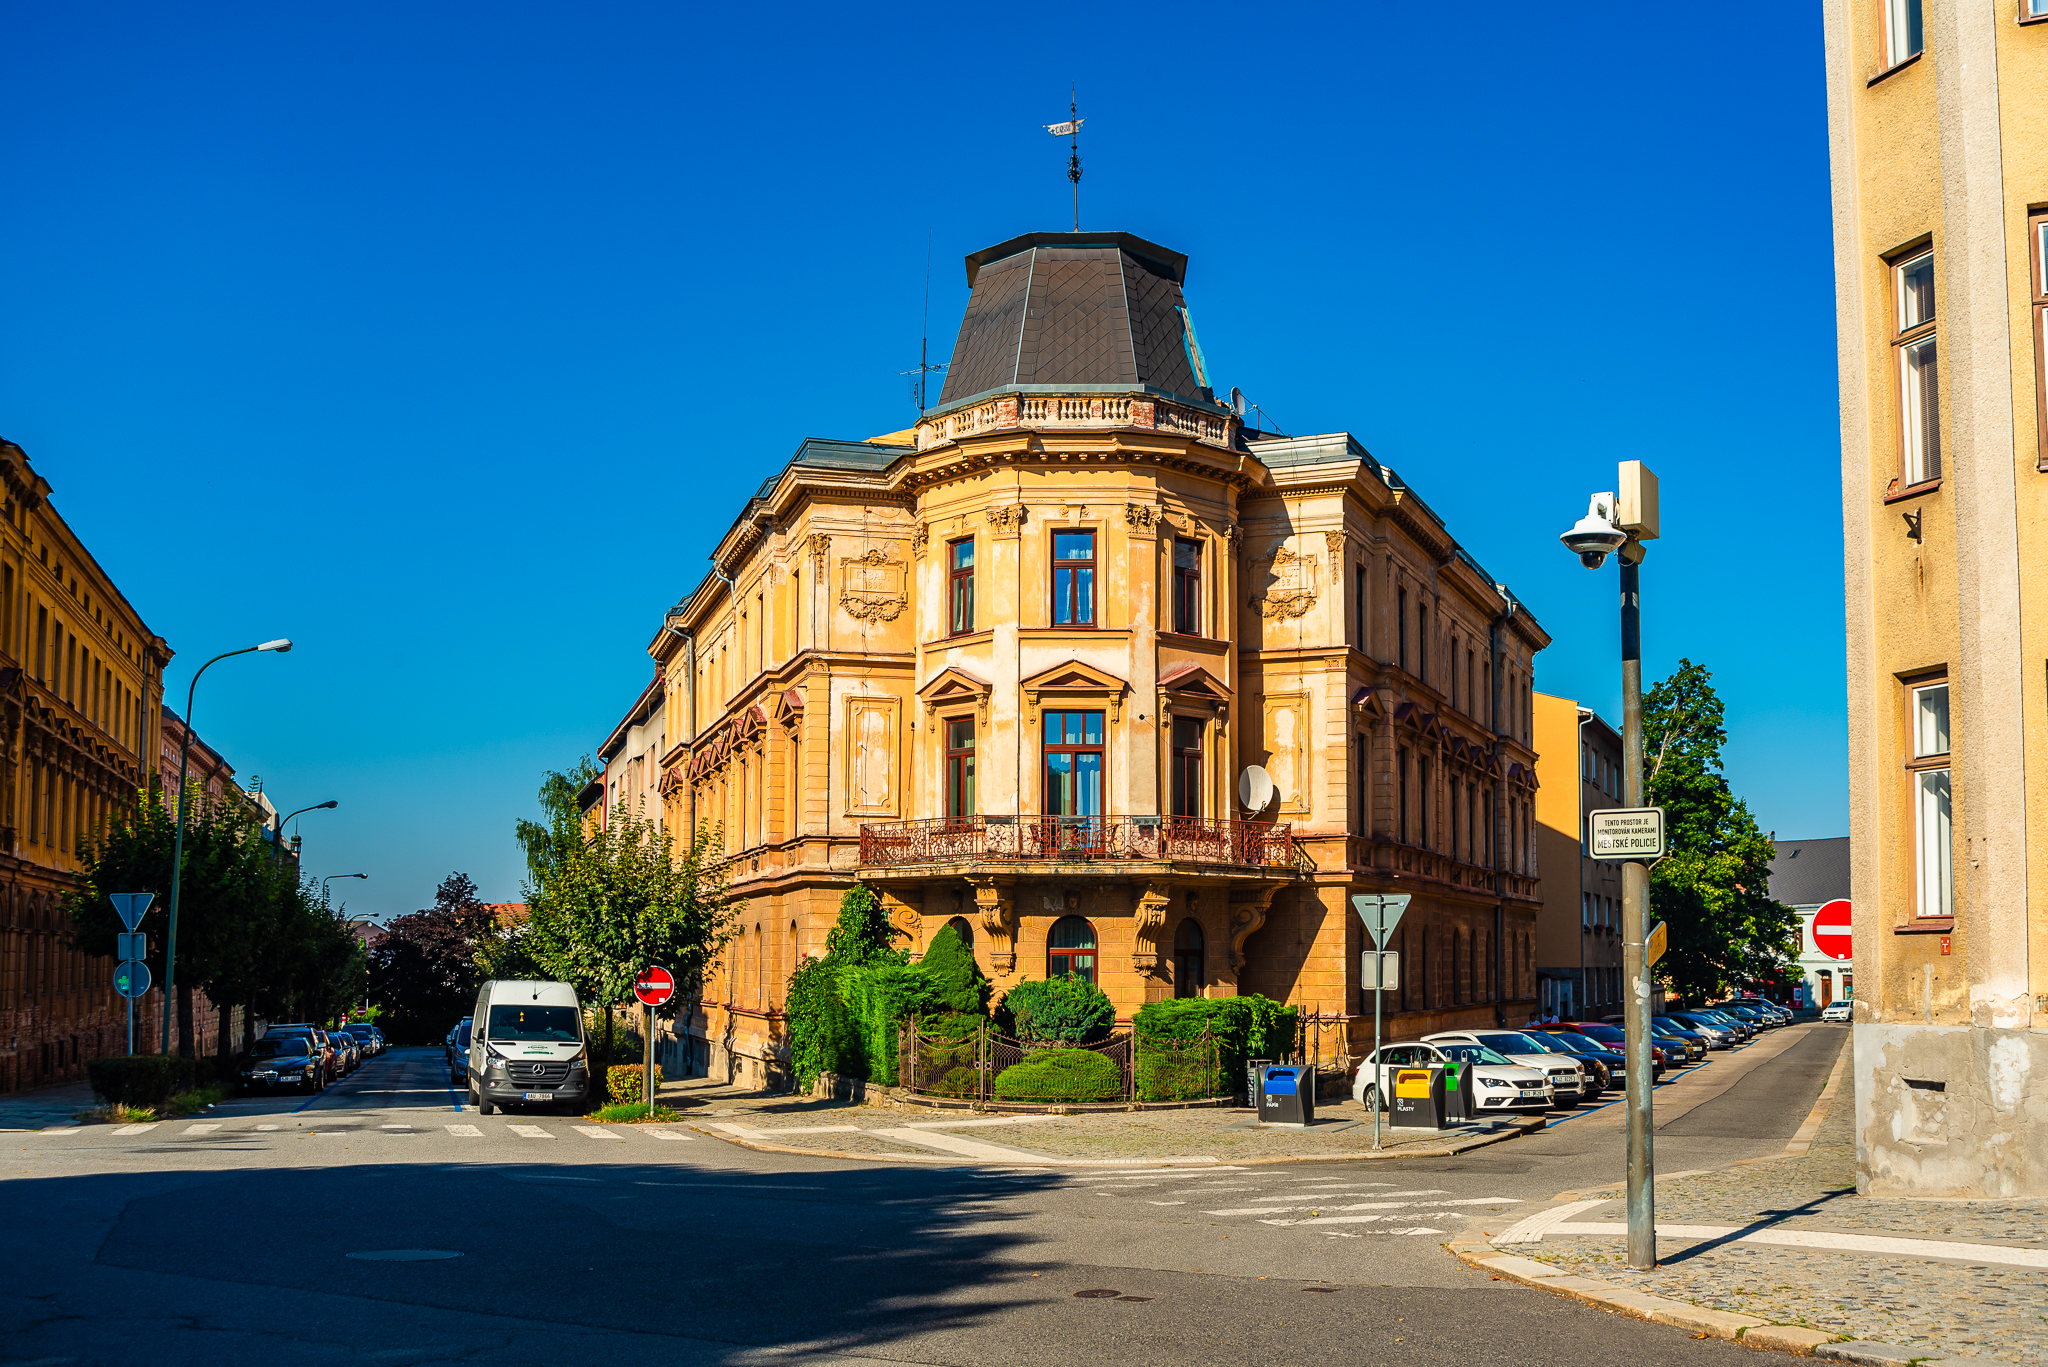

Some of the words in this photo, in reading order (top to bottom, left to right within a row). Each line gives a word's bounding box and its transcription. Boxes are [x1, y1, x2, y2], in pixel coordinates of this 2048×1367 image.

[1597, 827, 1630, 835] MONITOROVÁN
[1597, 837, 1629, 849] MĚSTSKÉ
[1630, 838, 1657, 848] POLICIE
